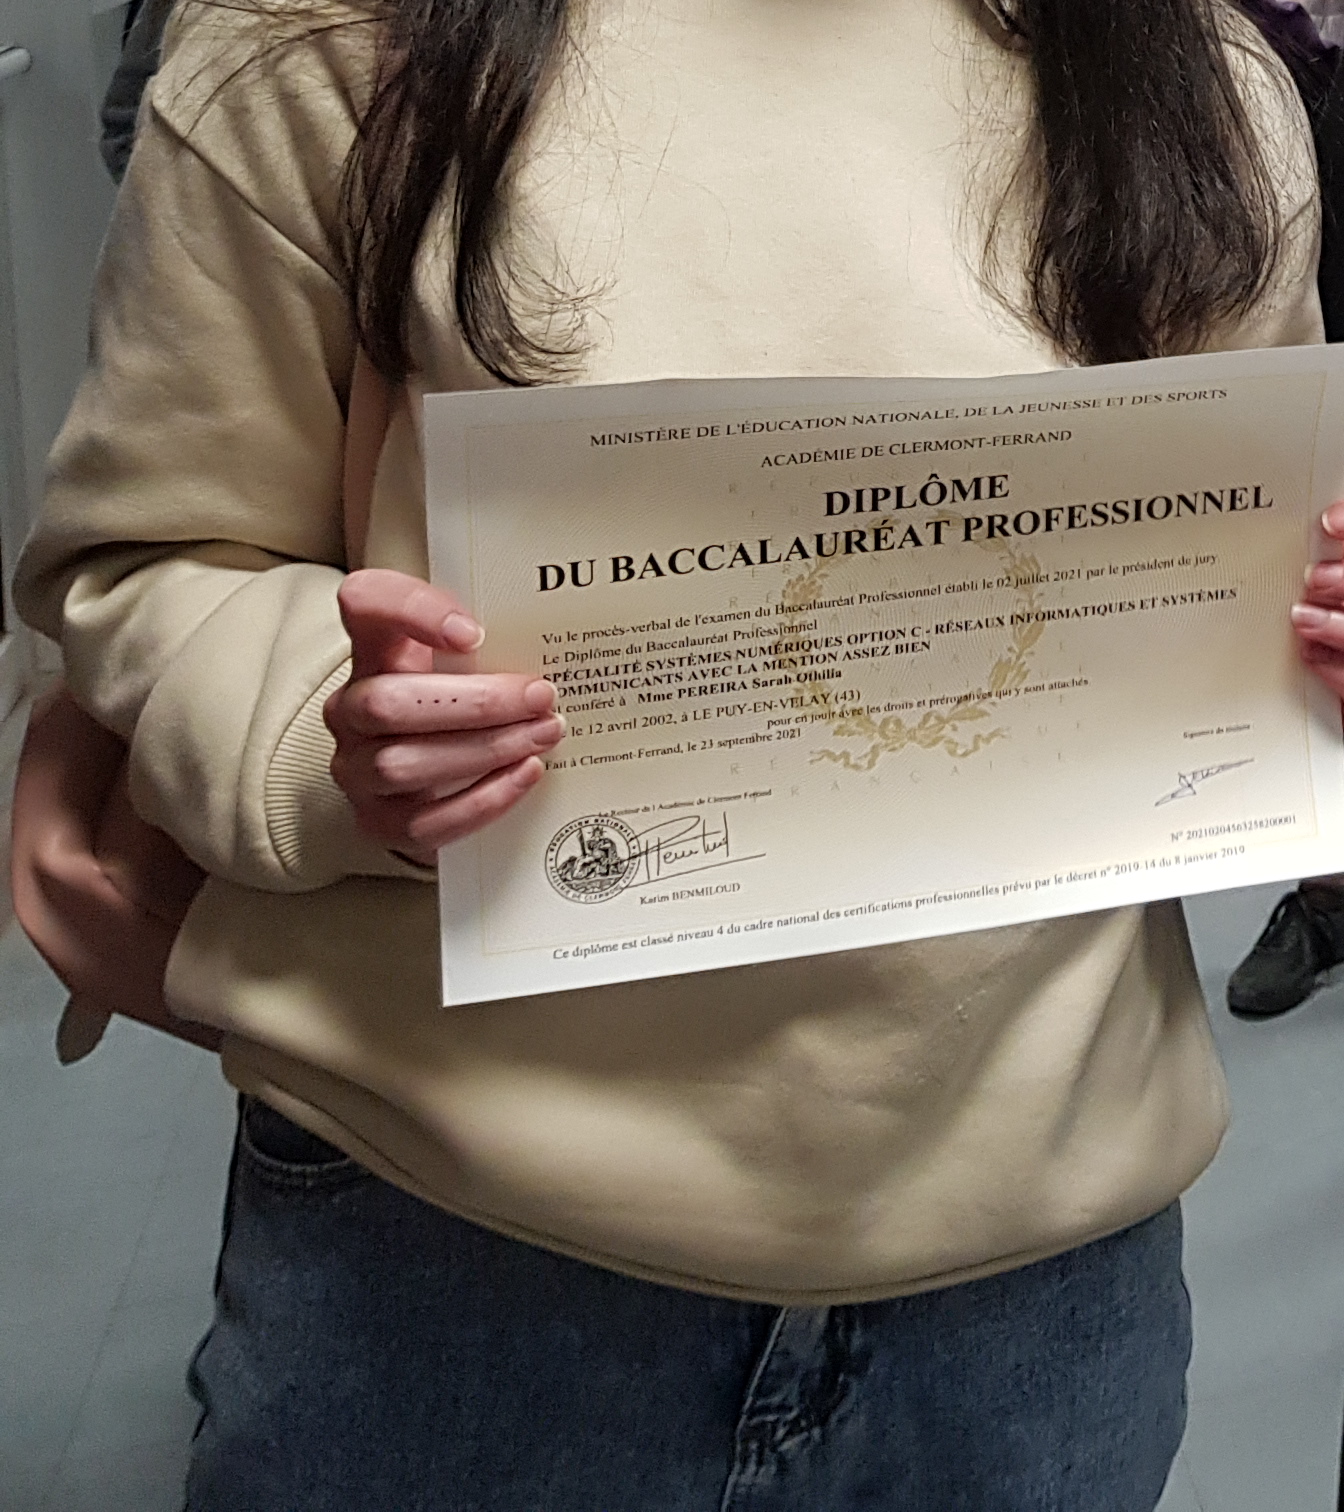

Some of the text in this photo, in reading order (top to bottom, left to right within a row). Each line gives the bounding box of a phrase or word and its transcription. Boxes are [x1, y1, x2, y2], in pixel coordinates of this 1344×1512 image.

[588, 388, 1230, 448] MINISTÈRE DE L'ÉDUCATION NATIONALE, DE LA JEUNESSE ET DES SPORTS
[760, 429, 1073, 469] ACADÉMIE DE CLERMONT-FERRAND
[823, 472, 1011, 518] DIPLÔME
[536, 485, 1274, 593] DU BACCALAURÉAT PROFESSIONNEL
[541, 588, 1239, 685] SPÉCIALITÉ SYSTÈMES NUMÉRIQUES OPTION C RÉSEAUX INFORMATIQUES ET SYSTÈMES
[541, 618, 819, 667] Le Diplôme du Baccalauréat Professionnel
[686, 664, 734, 683] AVEC
[736, 662, 759, 676] LA
[762, 650, 839, 673] MENTION
[841, 644, 892, 663] ASSEZ
[894, 639, 931, 656] BIEN
[565, 696, 616, 714] conféré
[618, 695, 627, 708] à
[637, 691, 674, 705] Mme
[676, 679, 749, 700] PEREIRA
[751, 673, 793, 691] Sarah
[570, 688, 862, 738] le 12 avril 2002, à LE PUY-EN-VELAY (43)
